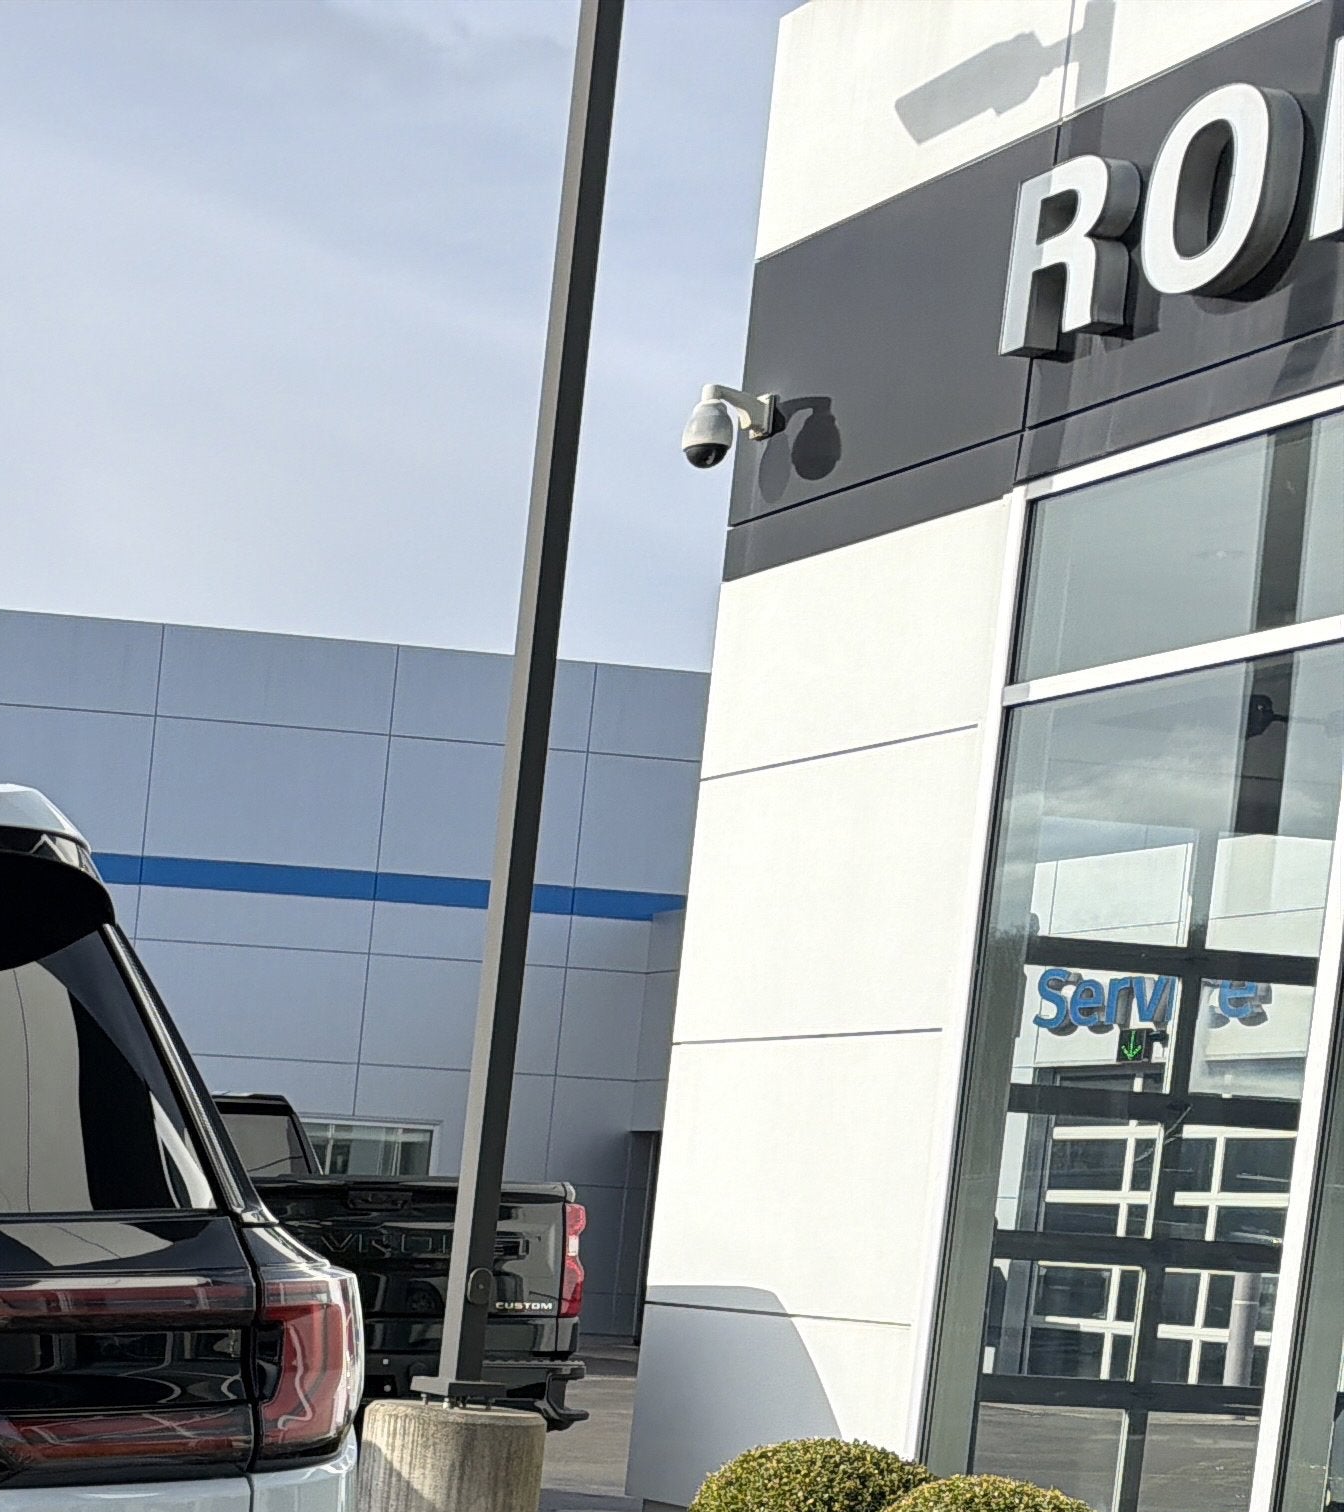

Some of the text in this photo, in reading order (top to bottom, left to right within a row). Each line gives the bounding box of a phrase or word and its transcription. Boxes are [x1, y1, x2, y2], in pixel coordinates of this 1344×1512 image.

[998, 36, 1344, 357] RO
[1033, 968, 1258, 1029] Servie
[495, 1301, 553, 1311] CUSTOM
